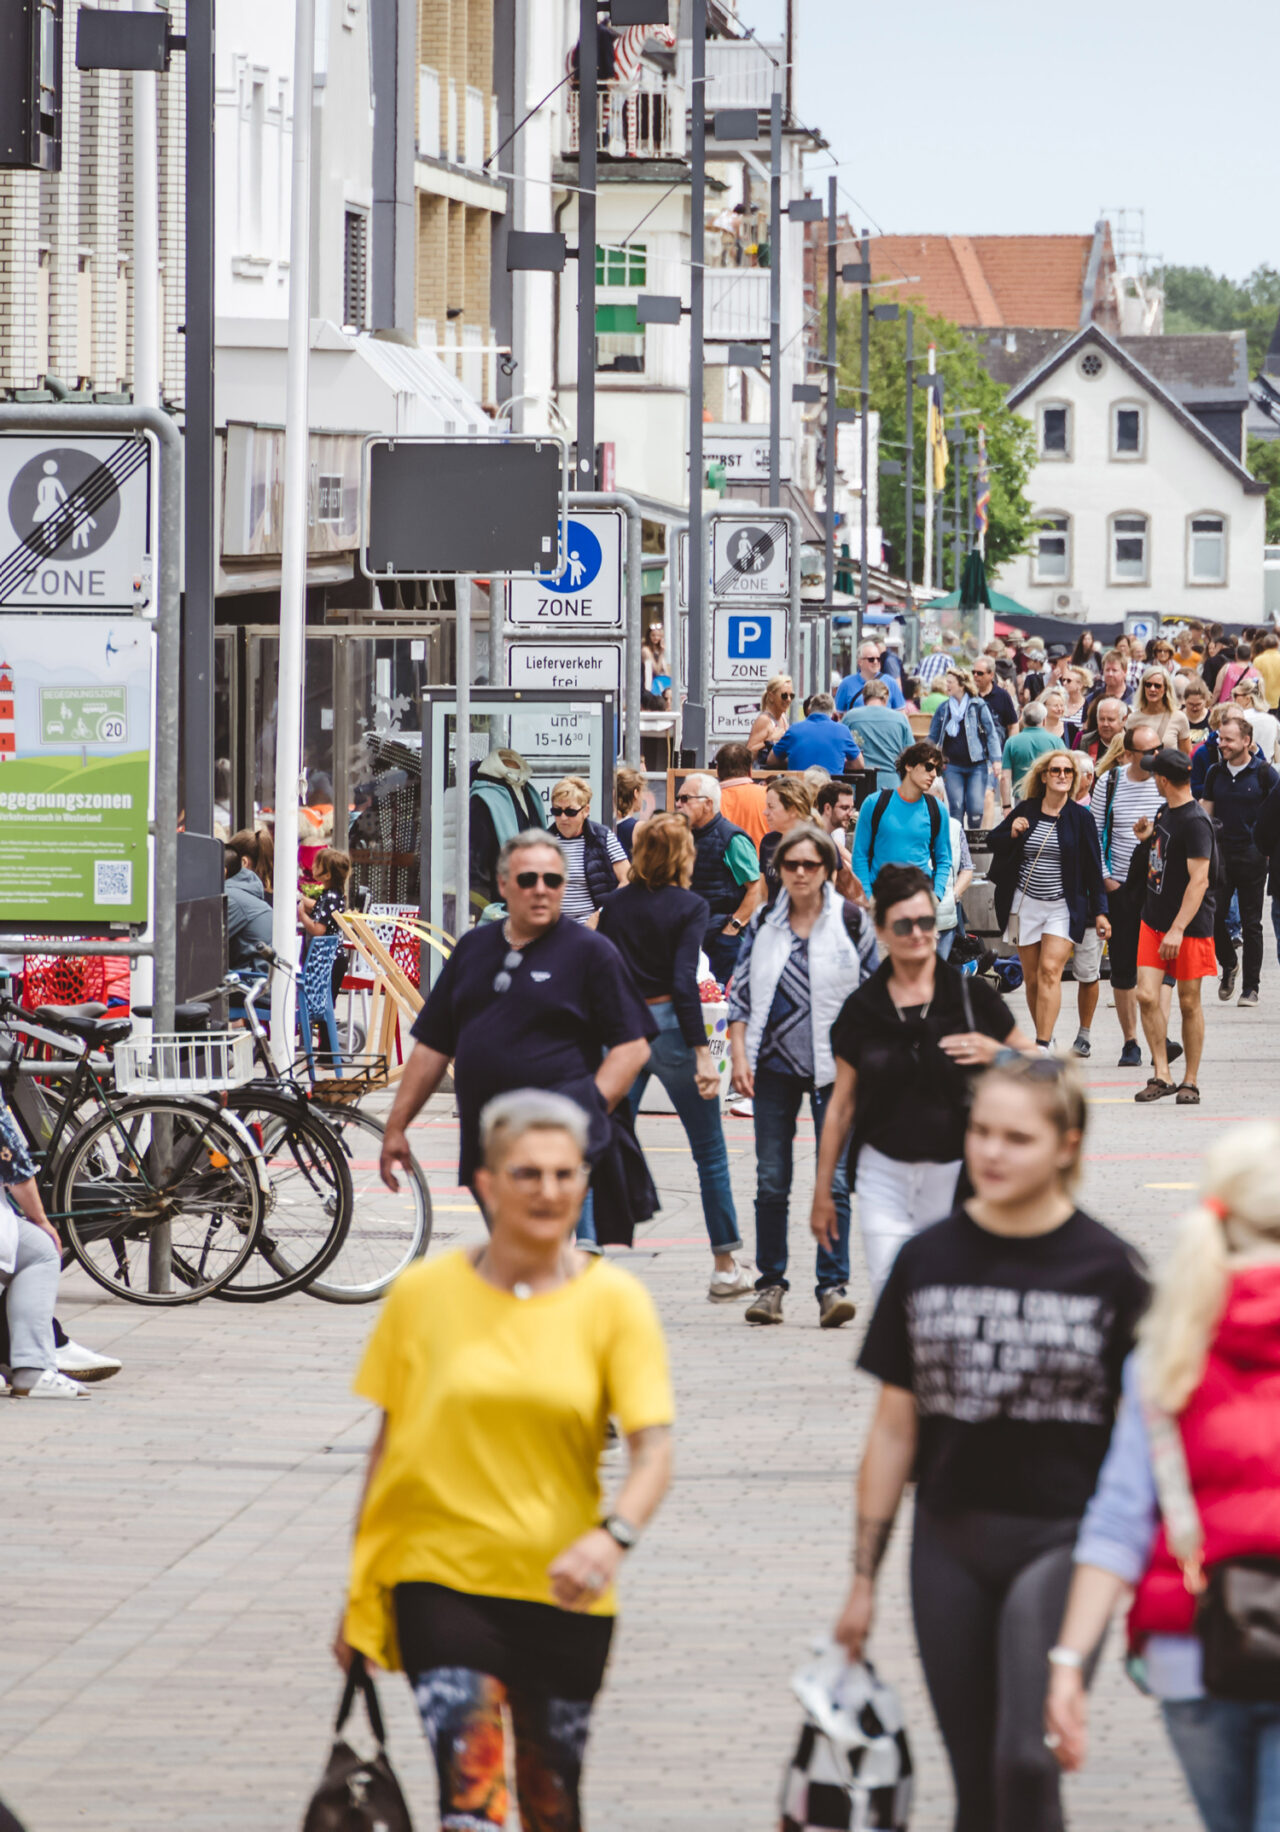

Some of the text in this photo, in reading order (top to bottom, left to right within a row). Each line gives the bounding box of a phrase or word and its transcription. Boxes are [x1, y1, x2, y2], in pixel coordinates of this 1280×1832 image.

[22, 570, 106, 596] ZONE
[732, 578, 769, 591] ZONE
[537, 599, 593, 616] ZONE
[738, 621, 762, 654] P
[526, 655, 603, 669] Lieferverkehr
[731, 664, 768, 677] ZONE
[552, 675, 578, 687] frei
[550, 713, 578, 727] und
[106, 722, 122, 737] 20
